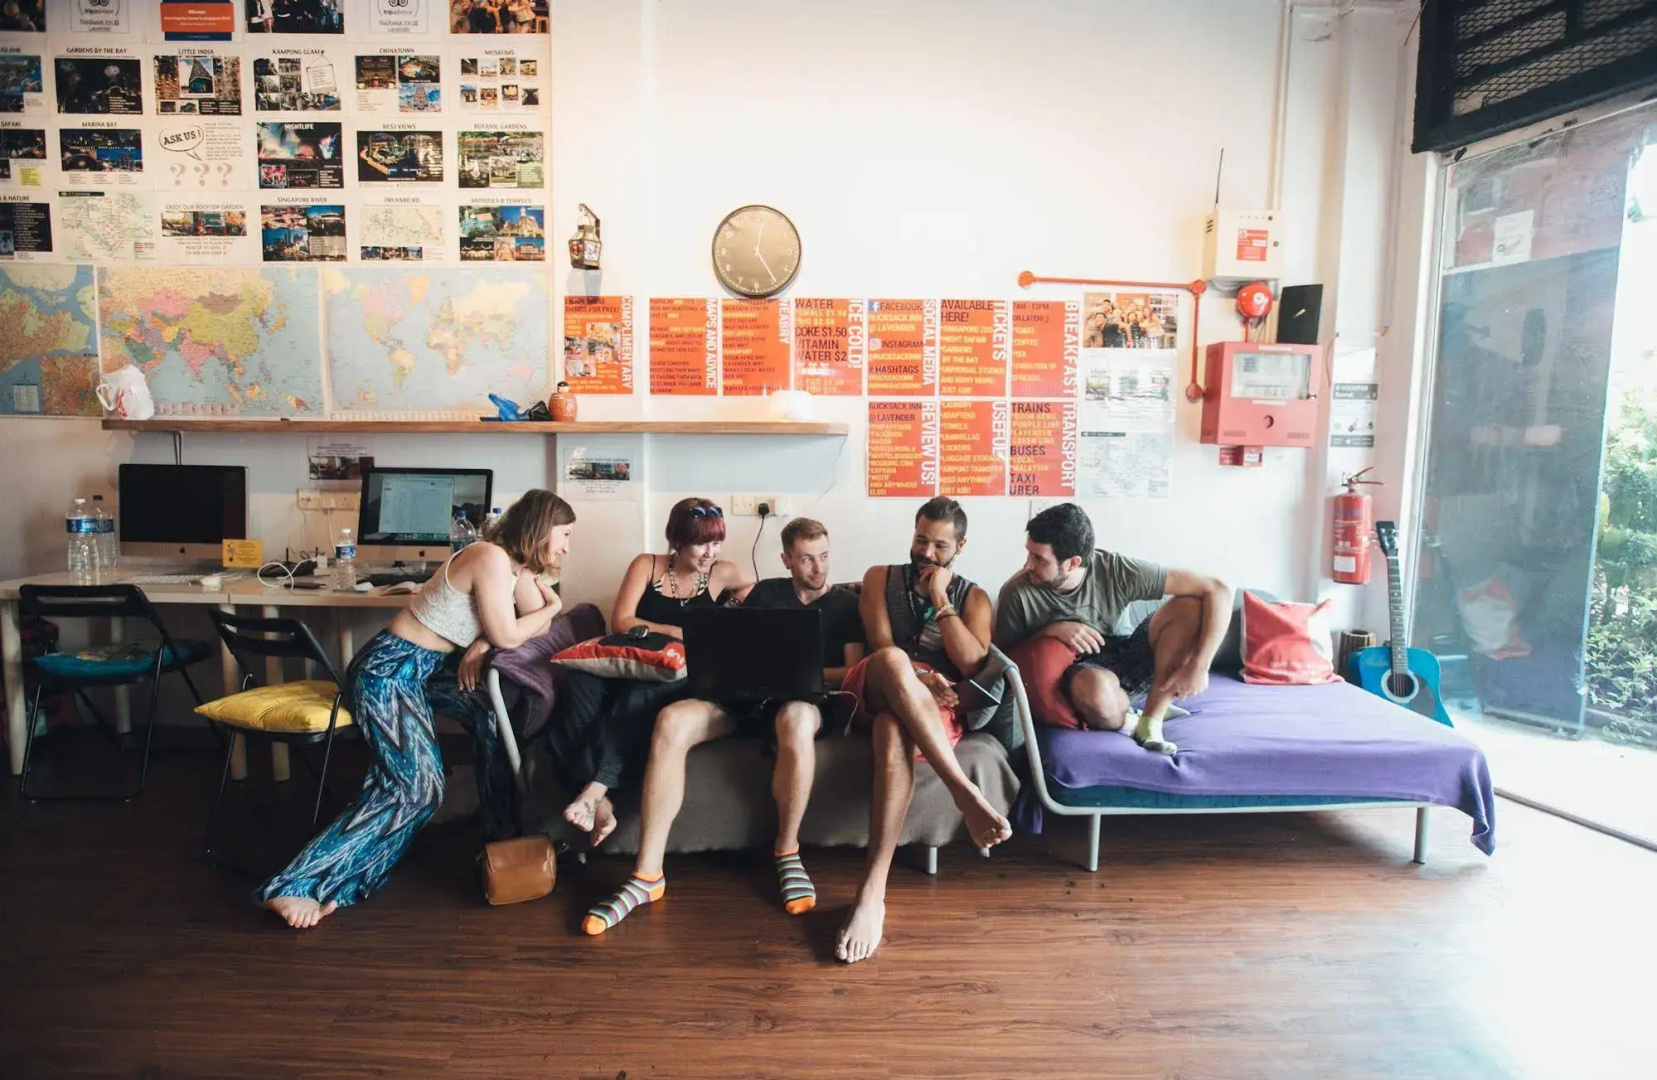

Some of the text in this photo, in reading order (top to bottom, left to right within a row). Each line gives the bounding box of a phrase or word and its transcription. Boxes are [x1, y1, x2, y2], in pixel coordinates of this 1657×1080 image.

[164, 133, 182, 146] ASK
[184, 130, 196, 141] US
[795, 299, 834, 309] WATER
[880, 302, 922, 310] FACEBOOK
[941, 300, 994, 310] AVAILABLE
[778, 299, 790, 344] NEARBY
[941, 312, 969, 322] HERE!
[795, 327, 847, 337] COKE $1.50
[878, 324, 916, 332] LAVENDER
[992, 299, 1008, 360] TICKETS
[848, 299, 863, 368] ICE COLD!
[621, 297, 632, 389] COMPLIMENTARY
[706, 298, 718, 389] MAPS AND ADVICE
[882, 340, 923, 348] INSTAGRAM
[923, 299, 935, 385] SOCIAL MEDIA
[1063, 302, 1078, 397] BREAKFAST
[834, 351, 847, 362] $2
[967, 356, 979, 364] BAY
[876, 365, 919, 374] HASHTAGS
[869, 402, 922, 410] RUCKSACK INN
[1012, 403, 1050, 413] TRAINS
[992, 402, 1006, 458] USEFUL
[921, 403, 935, 485] REVIEW US!
[1061, 401, 1076, 489] TRANSPORT
[1010, 446, 1046, 456] BUSES
[1010, 474, 1036, 483] TAXI
[1010, 485, 1039, 495] UBER
